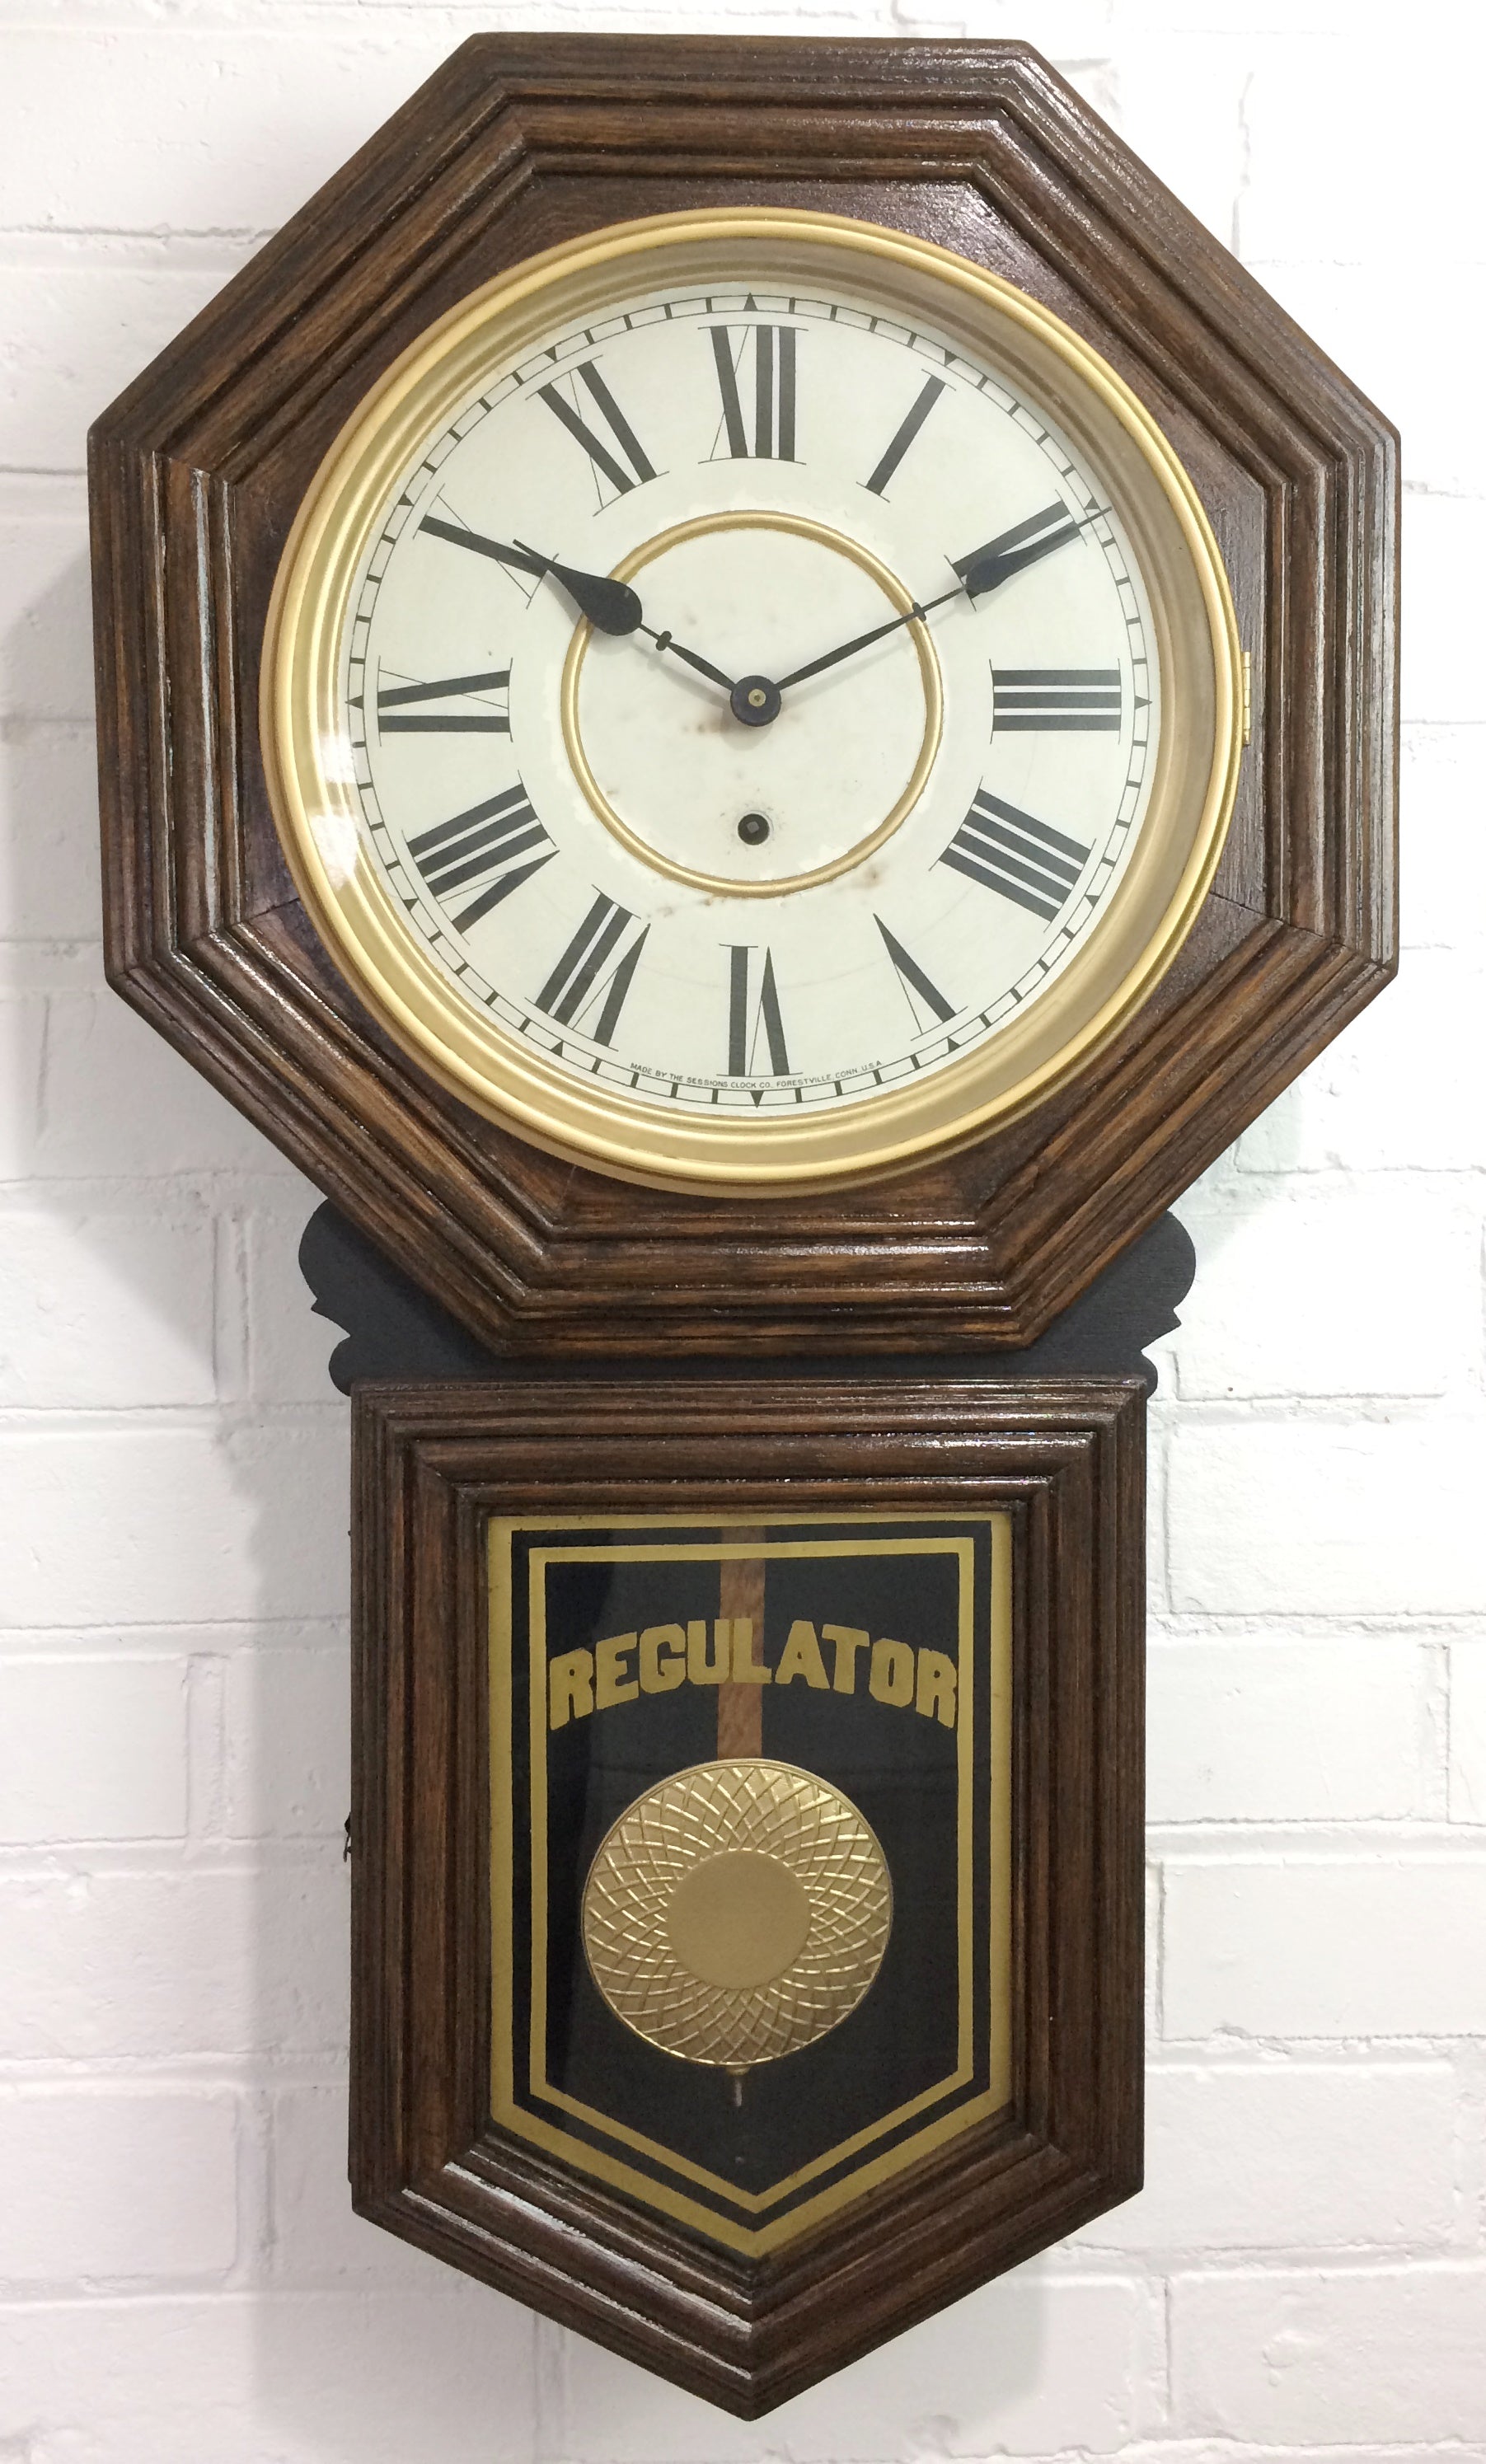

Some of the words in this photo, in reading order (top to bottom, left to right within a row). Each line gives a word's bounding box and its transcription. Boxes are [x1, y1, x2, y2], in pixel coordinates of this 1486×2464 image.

[525, 354, 670, 518] XI
[697, 323, 809, 466] XII
[855, 368, 957, 504] I
[412, 483, 560, 610] X
[377, 656, 514, 747] IX
[988, 658, 1123, 745] III
[401, 770, 561, 947] VIII
[927, 776, 1097, 934] IIII
[524, 884, 652, 1052] VII
[716, 943, 804, 1078] VI
[872, 911, 969, 1042] V
[630, 1062, 653, 1075] MADE
[655, 1070, 668, 1079] BY
[669, 1073, 683, 1081] THE
[686, 1076, 729, 1088] SESSIONS
[549, 1618, 958, 1731] REGULATOR
